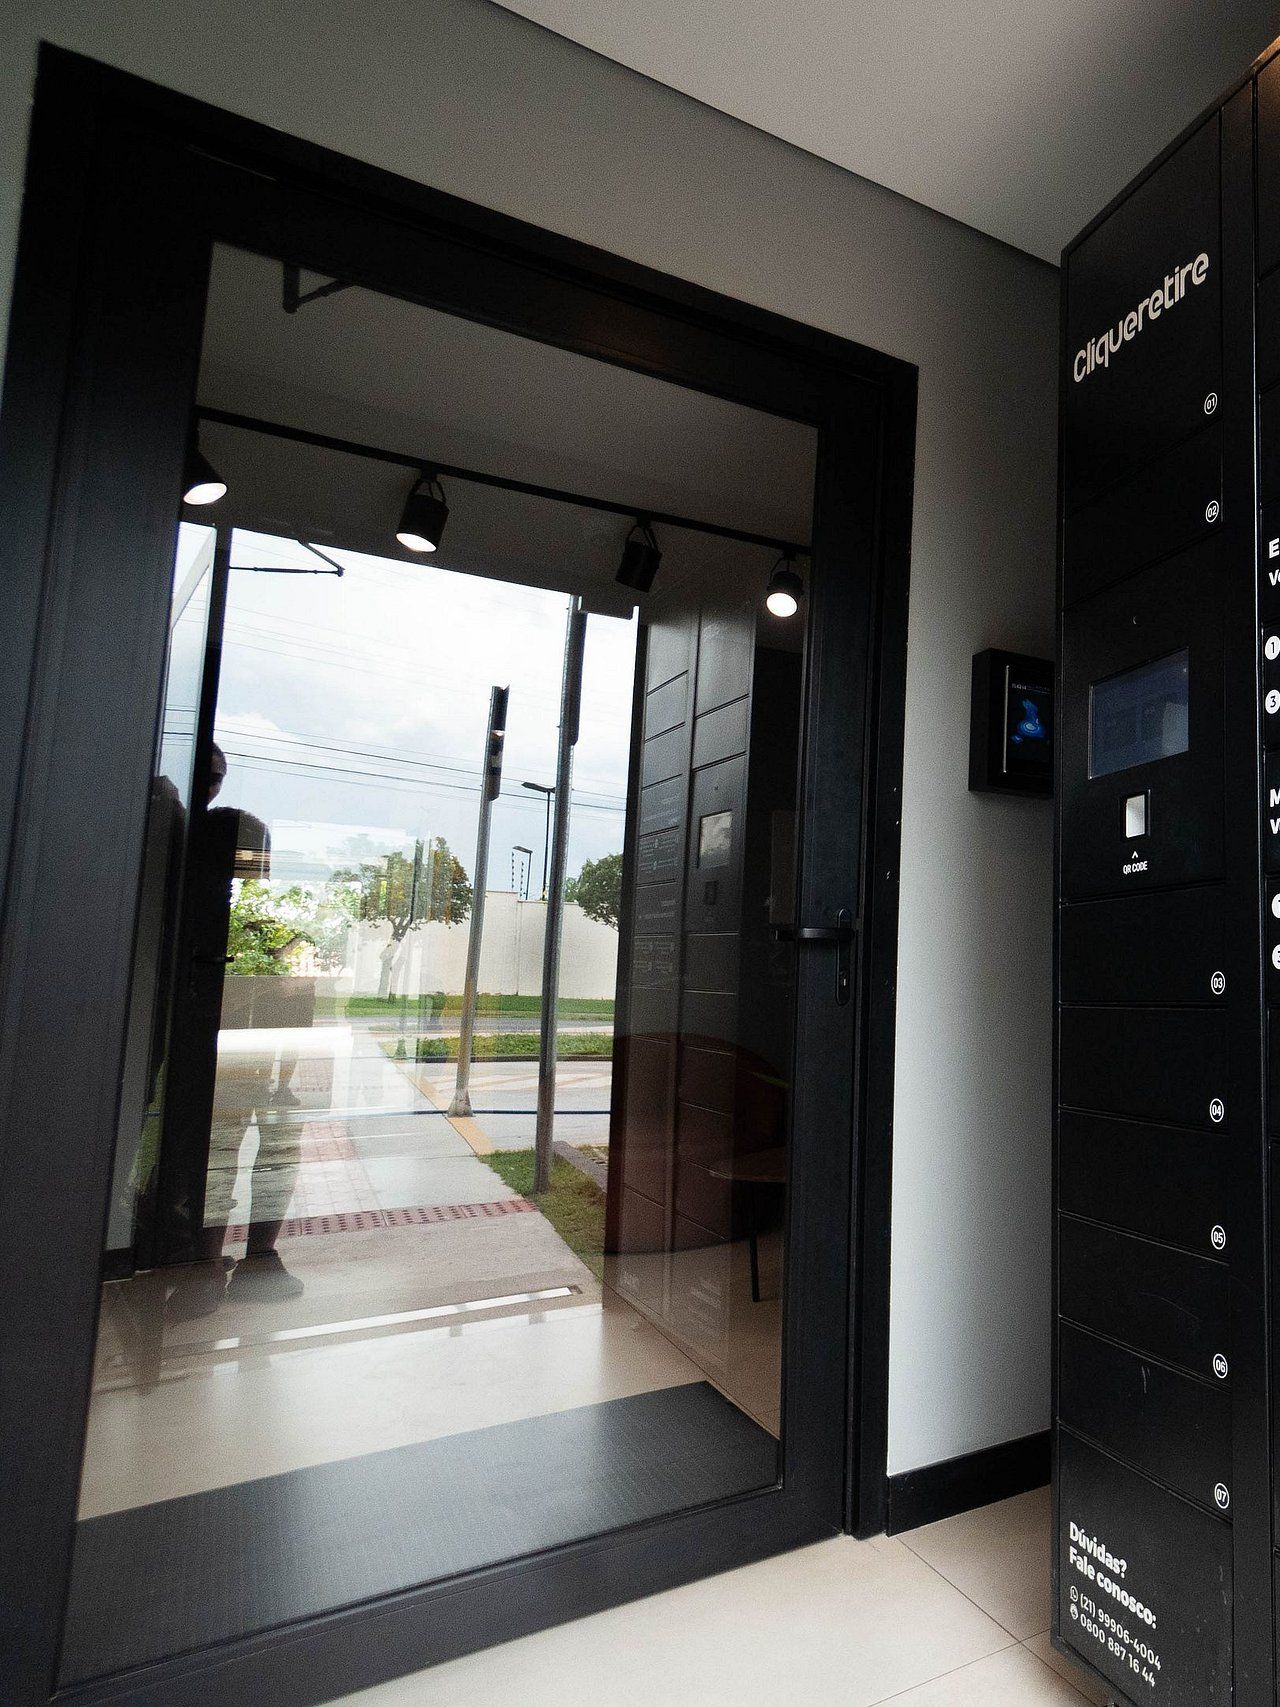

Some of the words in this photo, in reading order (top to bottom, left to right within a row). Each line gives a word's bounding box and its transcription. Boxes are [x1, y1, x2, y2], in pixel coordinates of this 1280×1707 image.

[1123, 865, 1131, 875] QR
[1132, 861, 1148, 872] CODE
[1069, 1521, 1127, 1579] Dúvidas?
[1069, 1545, 1095, 1581] Fale
[1096, 1571, 1157, 1630] conosco:
[1080, 1593, 1096, 1618] (21)
[1098, 1608, 1162, 1671] 99906-4004
[1080, 1613, 1106, 1644] 0800
[1107, 1637, 1127, 1661] 887
[1128, 1653, 1140, 1673] 16
[1141, 1666, 1156, 1687] 44
